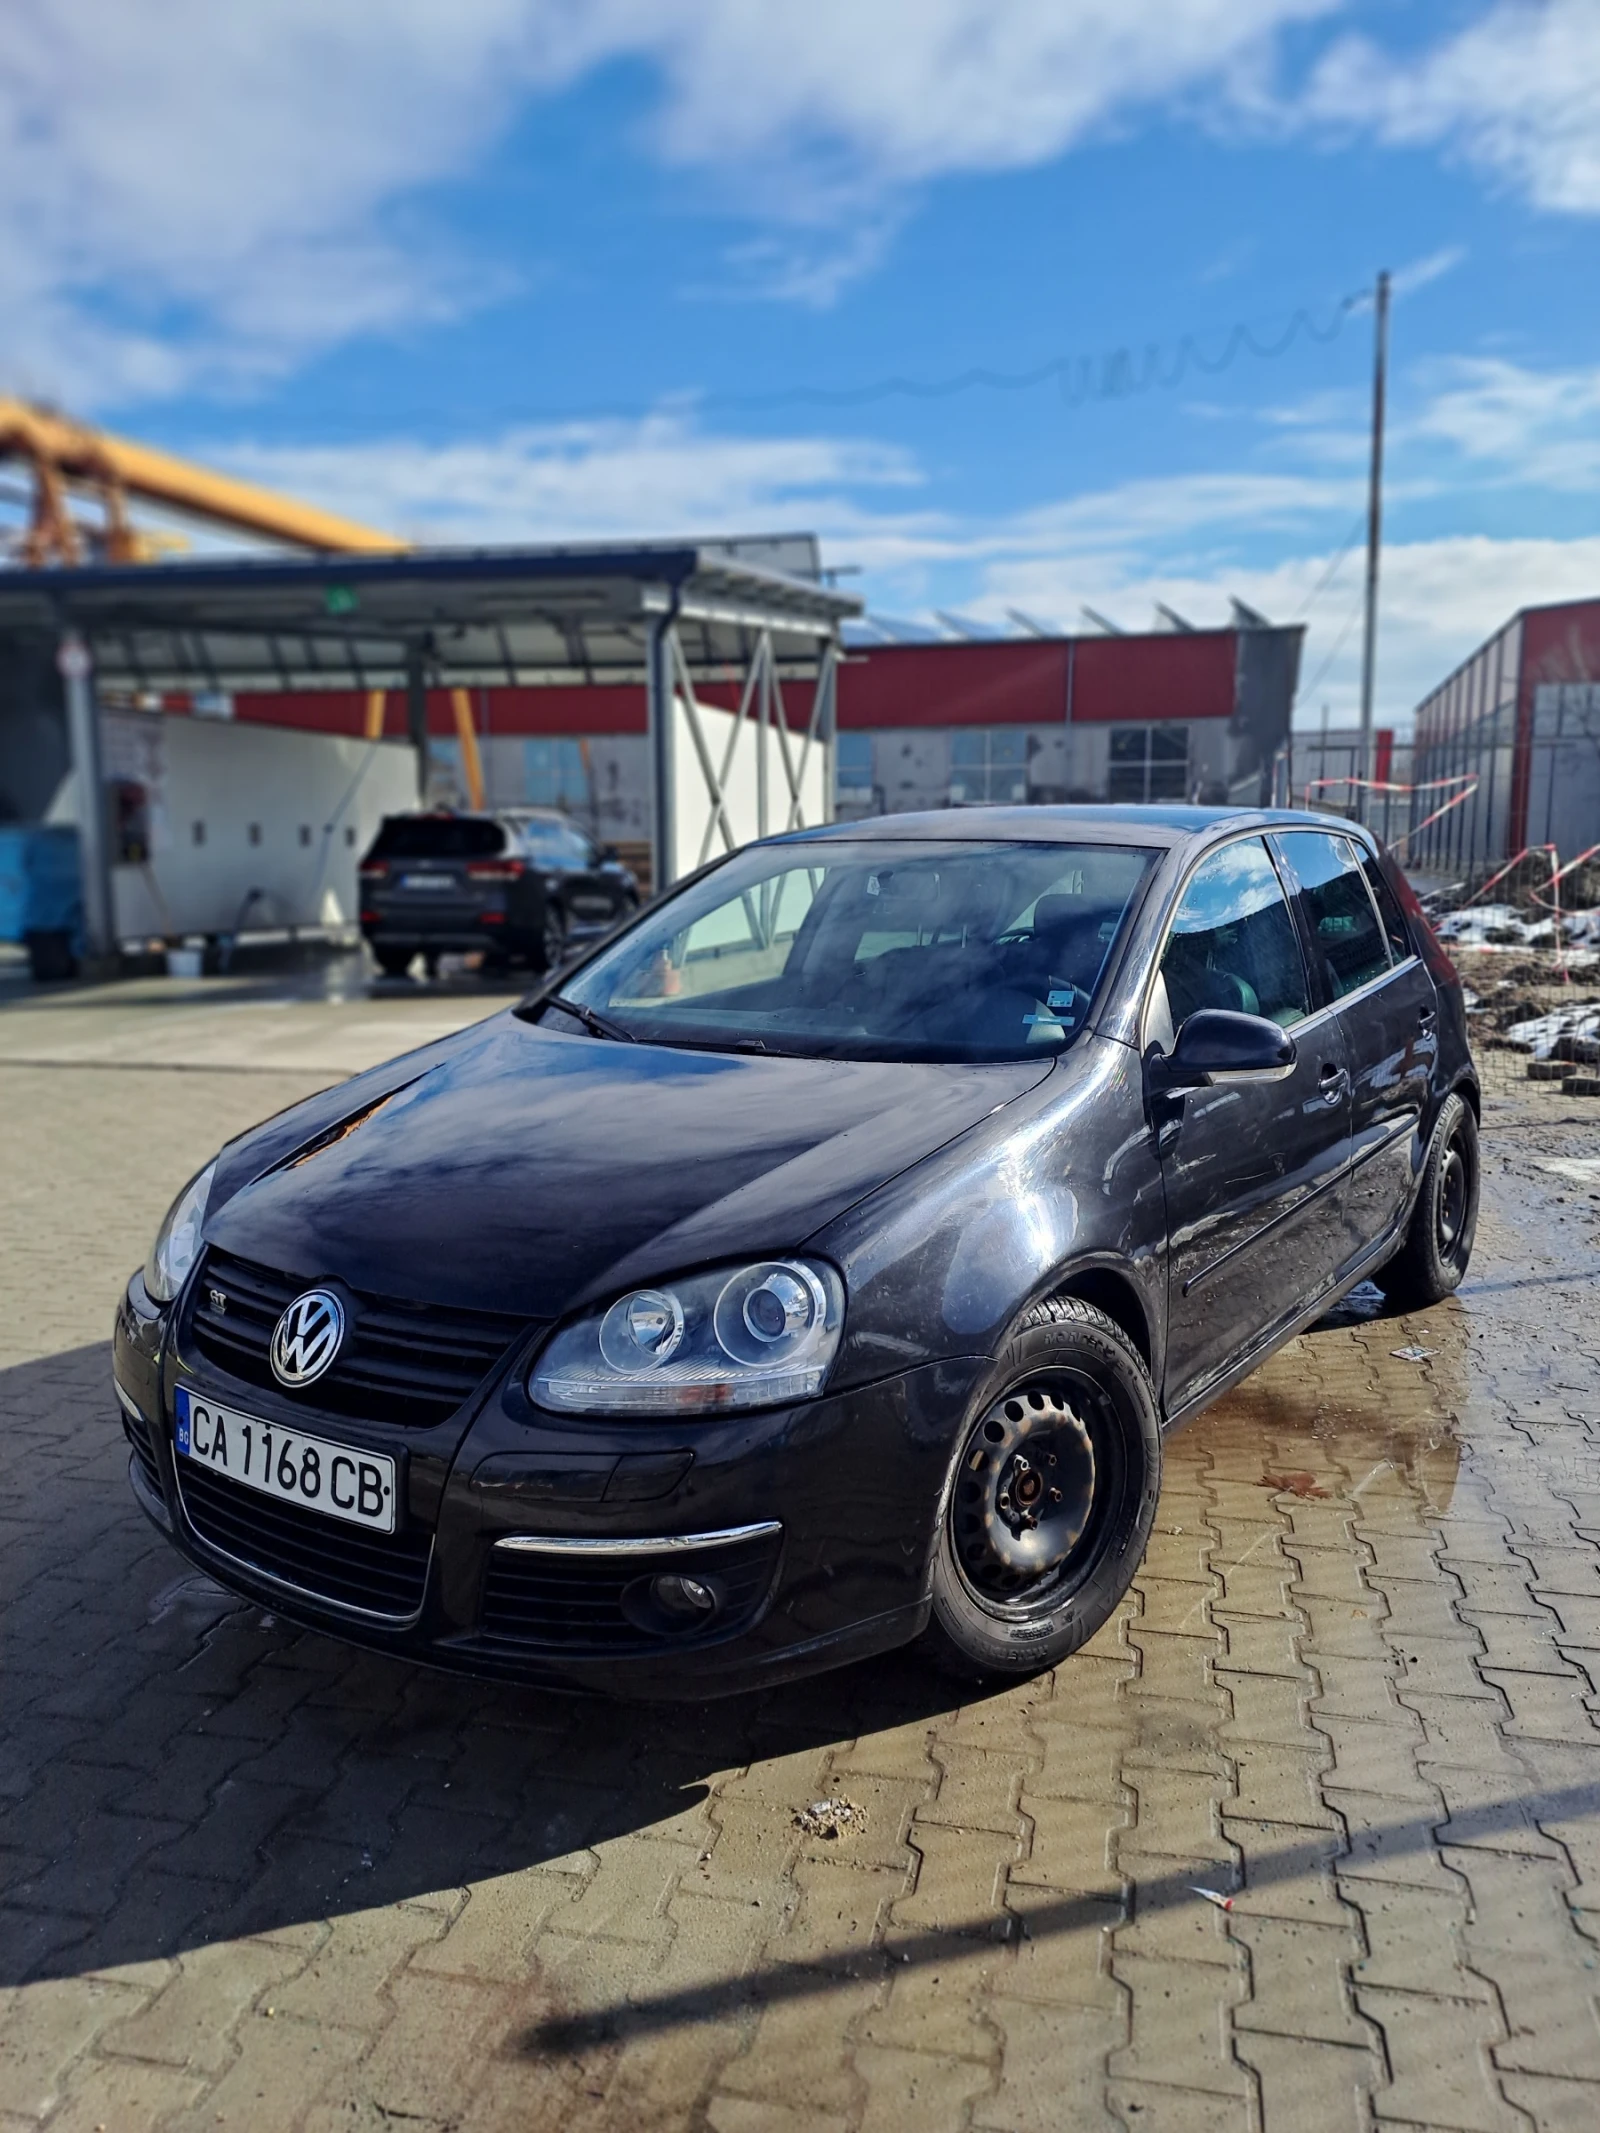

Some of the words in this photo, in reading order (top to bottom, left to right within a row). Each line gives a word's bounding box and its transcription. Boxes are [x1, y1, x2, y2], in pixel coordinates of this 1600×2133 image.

[209, 1289, 227, 1307] GT
[178, 1427, 190, 1446] BG
[193, 1405, 228, 1467] CA
[241, 1424, 321, 1499] 1168
[330, 1455, 384, 1518] CB
